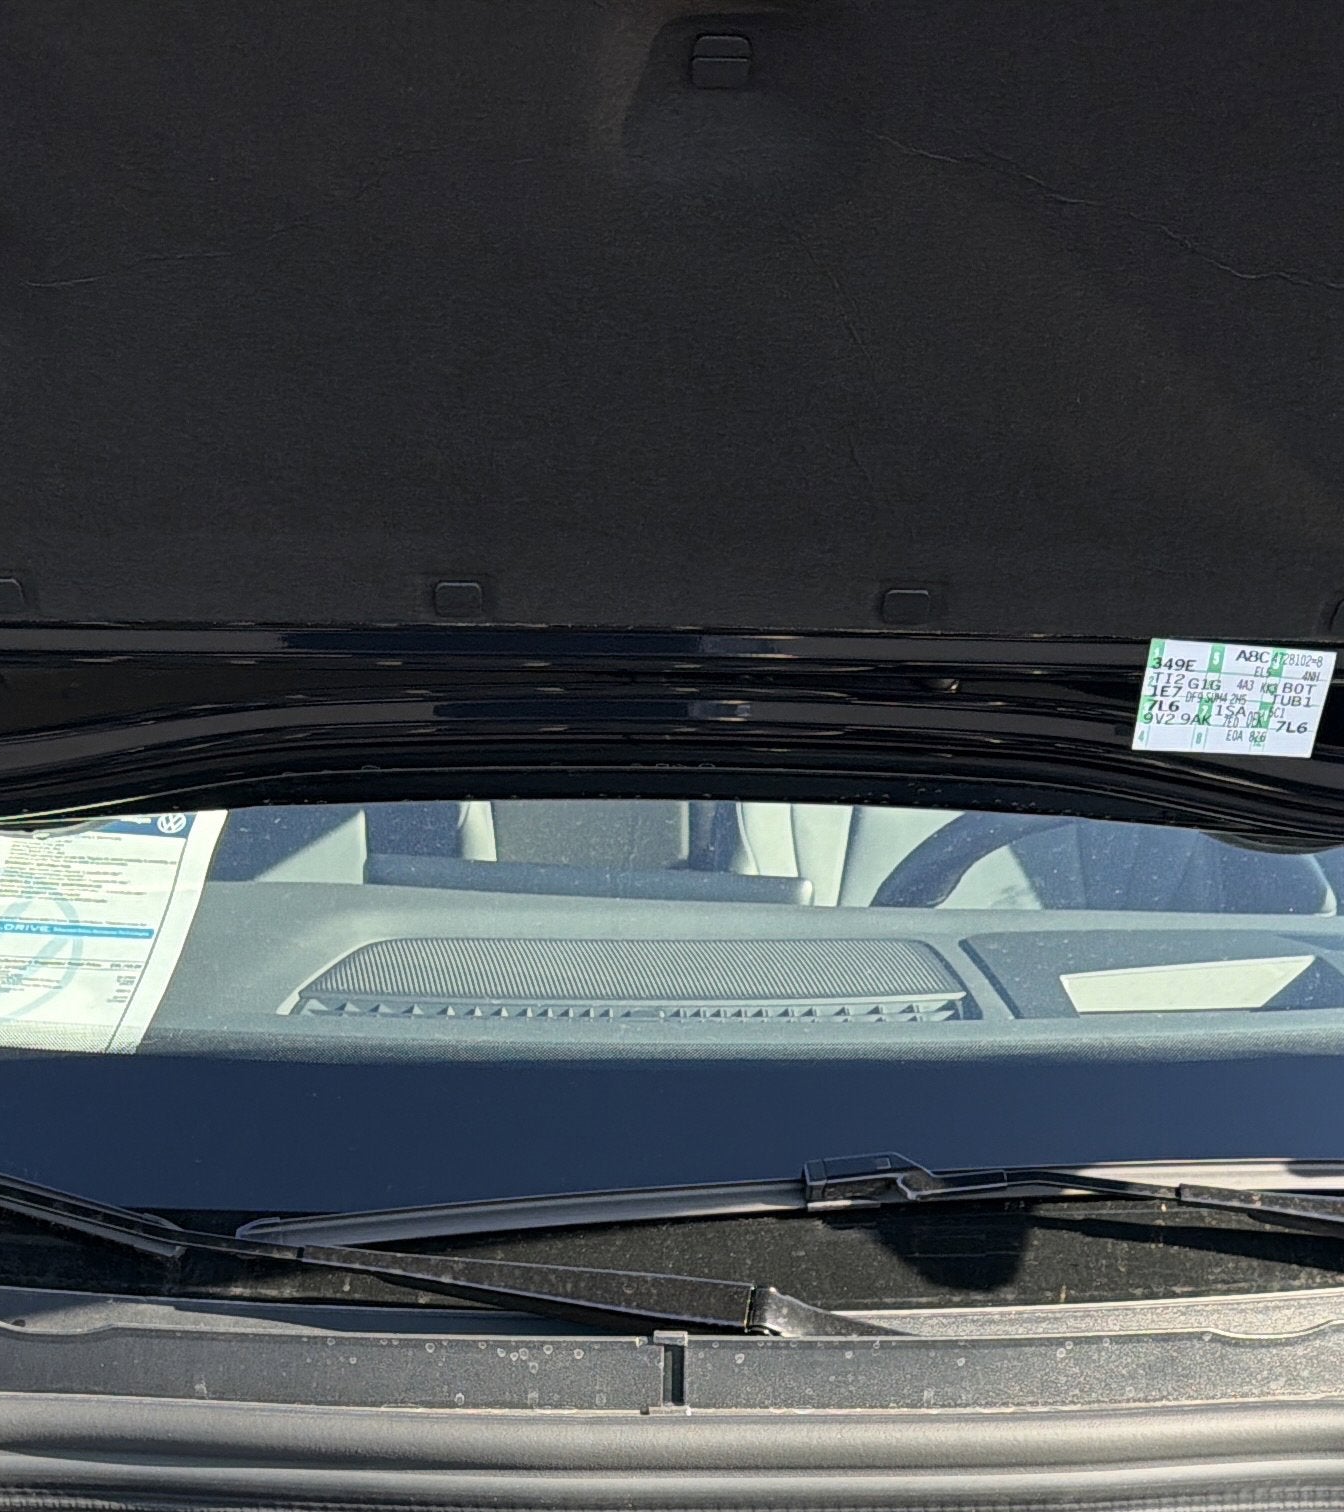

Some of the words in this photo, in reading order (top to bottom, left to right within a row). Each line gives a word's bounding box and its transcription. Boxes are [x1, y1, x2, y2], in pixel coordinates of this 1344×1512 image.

[1235, 650, 1270, 664] A8C
[1152, 656, 1197, 672] 349E
[1154, 672, 1186, 684] TI2
[1188, 678, 1222, 690] G1G
[1237, 678, 1254, 691] 4A3
[1150, 686, 1183, 698] 1E7
[1146, 700, 1180, 712] 7L6
[1215, 704, 1246, 717] 1SA
[1144, 712, 1176, 724] 9V2
[1180, 713, 1212, 726] 9AK
[1276, 720, 1308, 734] 7L6
